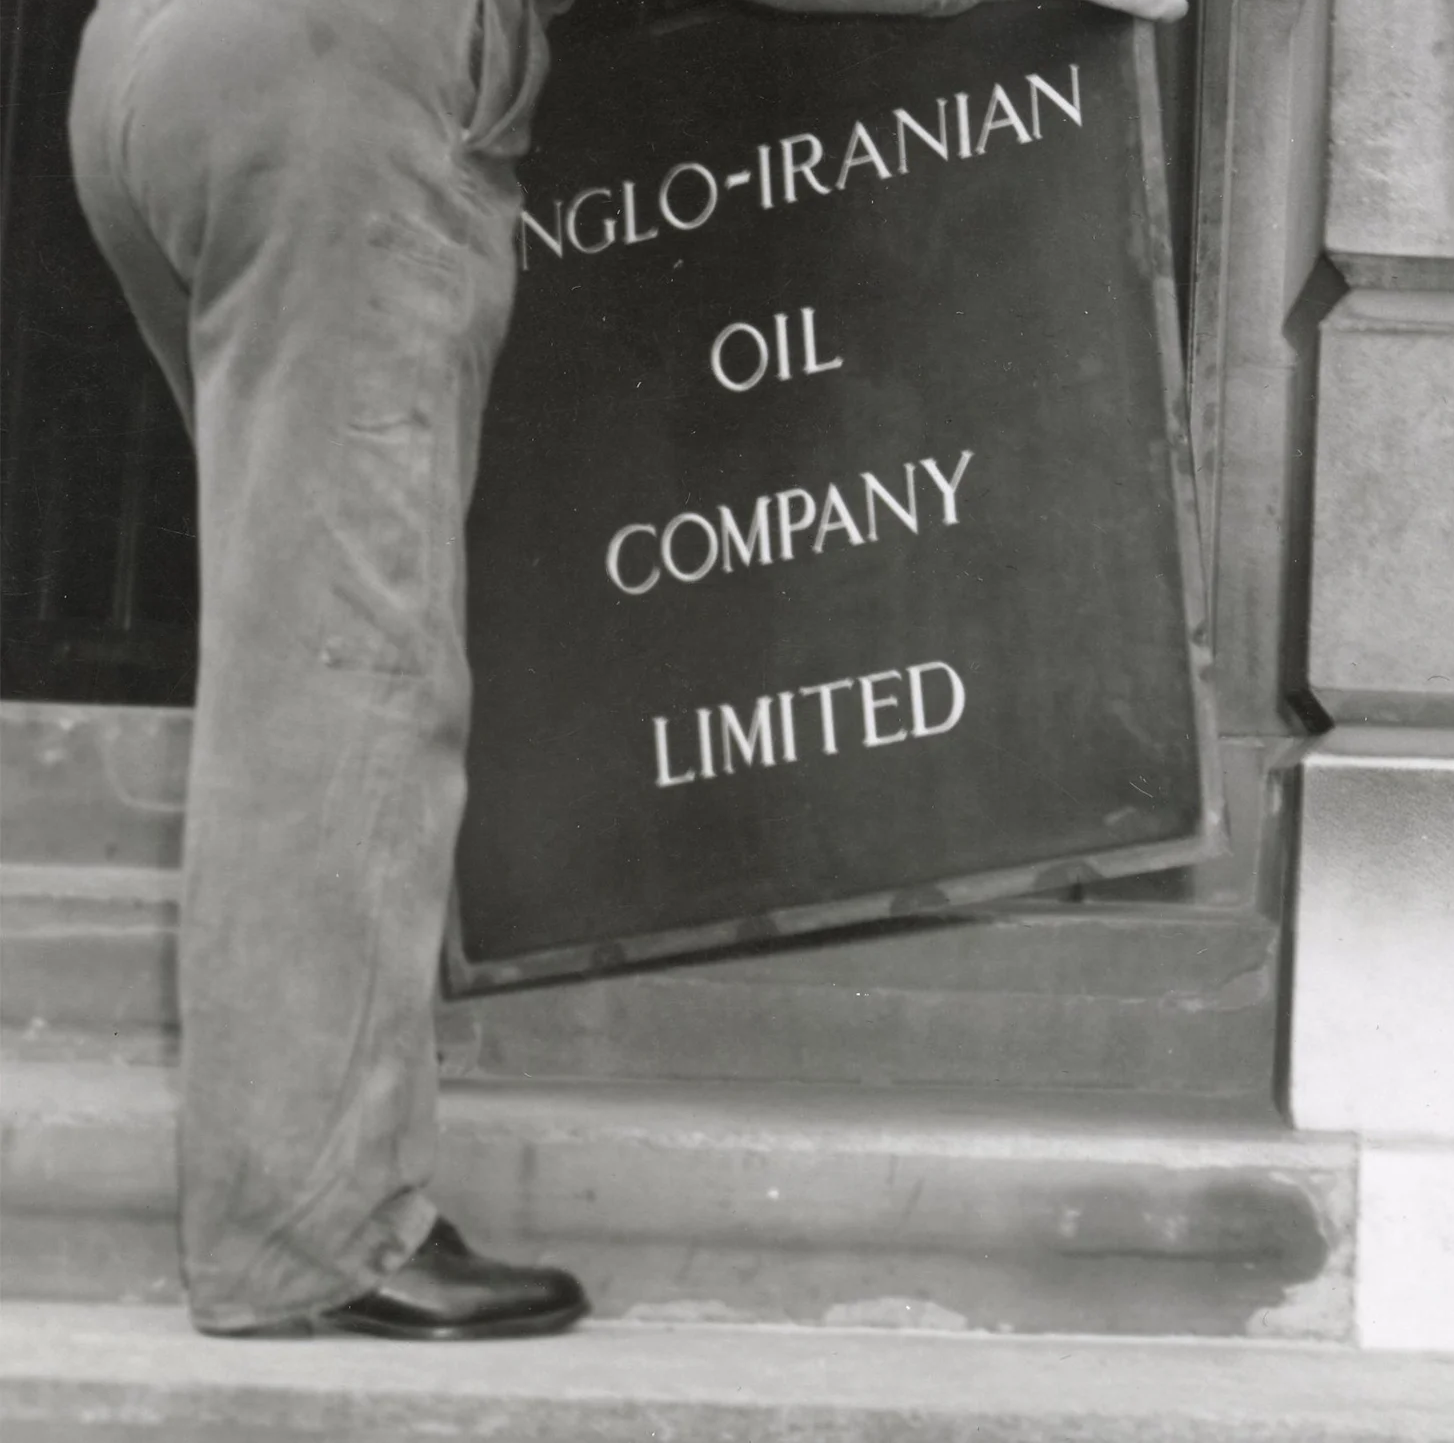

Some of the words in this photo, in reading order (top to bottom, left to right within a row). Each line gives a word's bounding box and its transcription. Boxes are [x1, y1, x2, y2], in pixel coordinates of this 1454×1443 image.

[519, 64, 1084, 271] NGLO-IRANIAN
[710, 307, 844, 392] OIL
[606, 450, 974, 594] COMPANY
[653, 661, 967, 788] LIMITED
